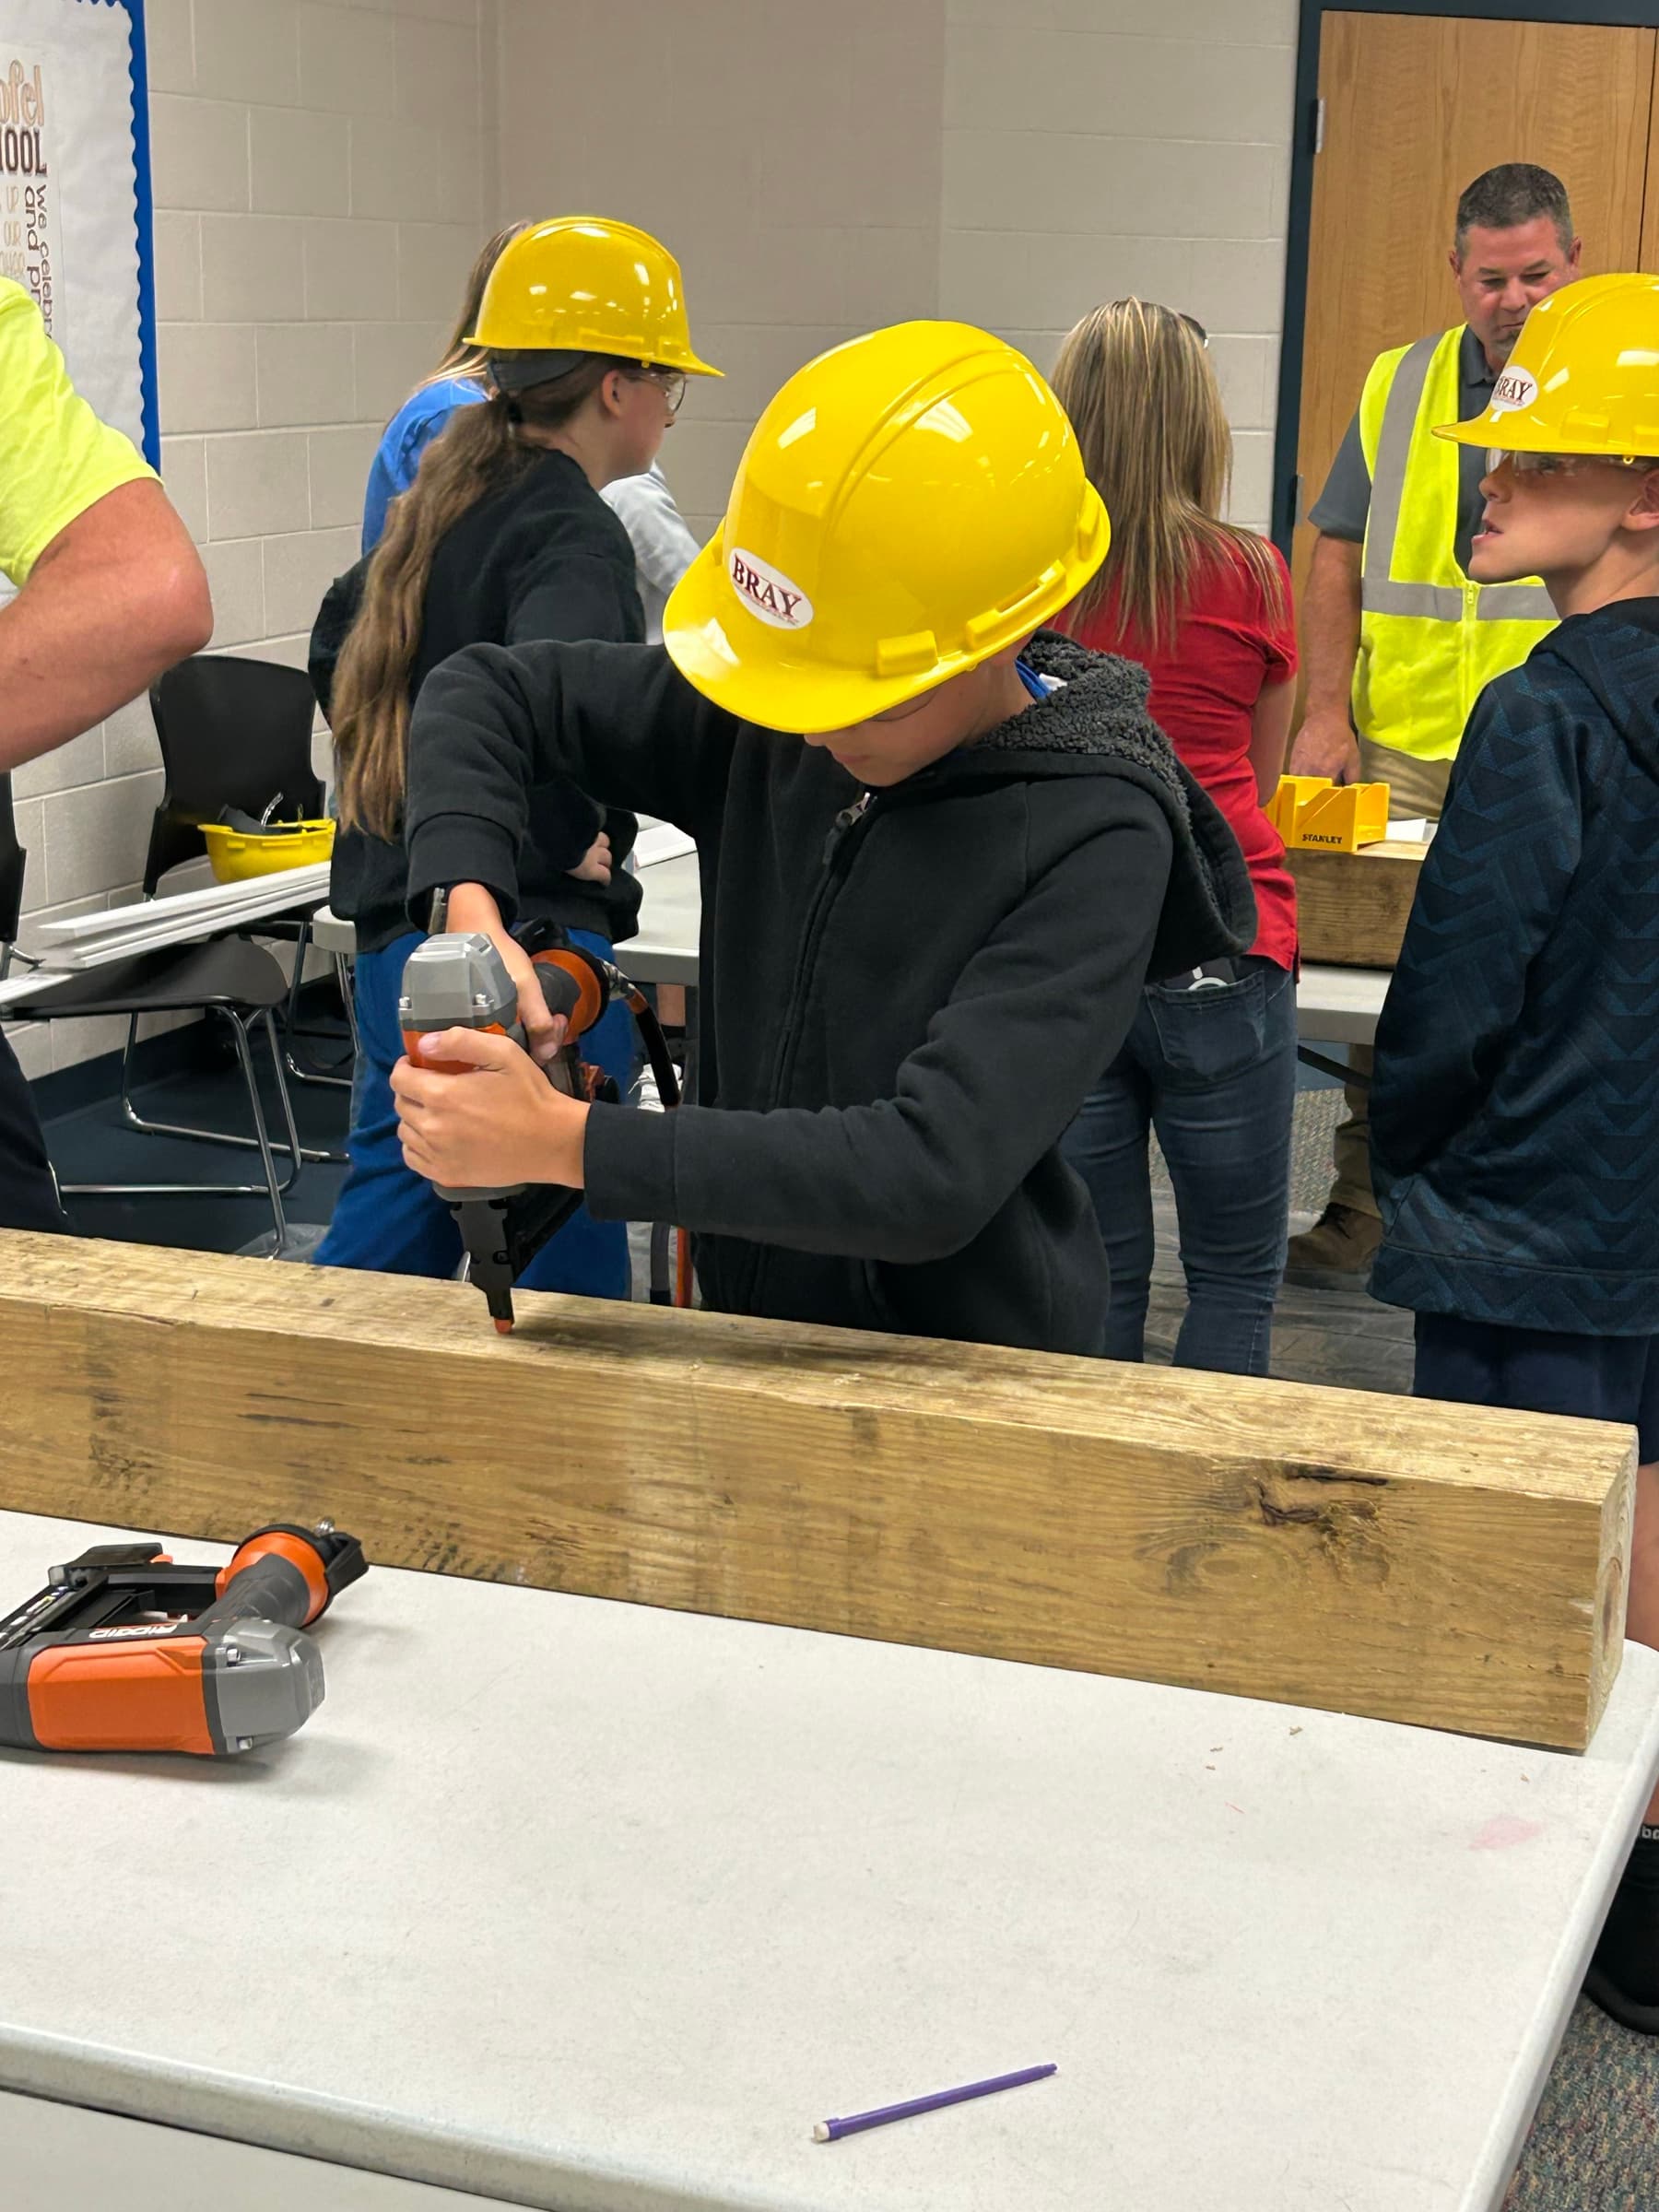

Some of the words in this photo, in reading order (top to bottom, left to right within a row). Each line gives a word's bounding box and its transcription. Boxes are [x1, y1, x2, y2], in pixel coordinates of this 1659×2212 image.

[0, 127, 48, 178] OOL
[25, 185, 40, 251] and
[37, 184, 47, 229] we
[732, 553, 802, 618] BRAY
[1301, 833, 1343, 844] STANLEY
